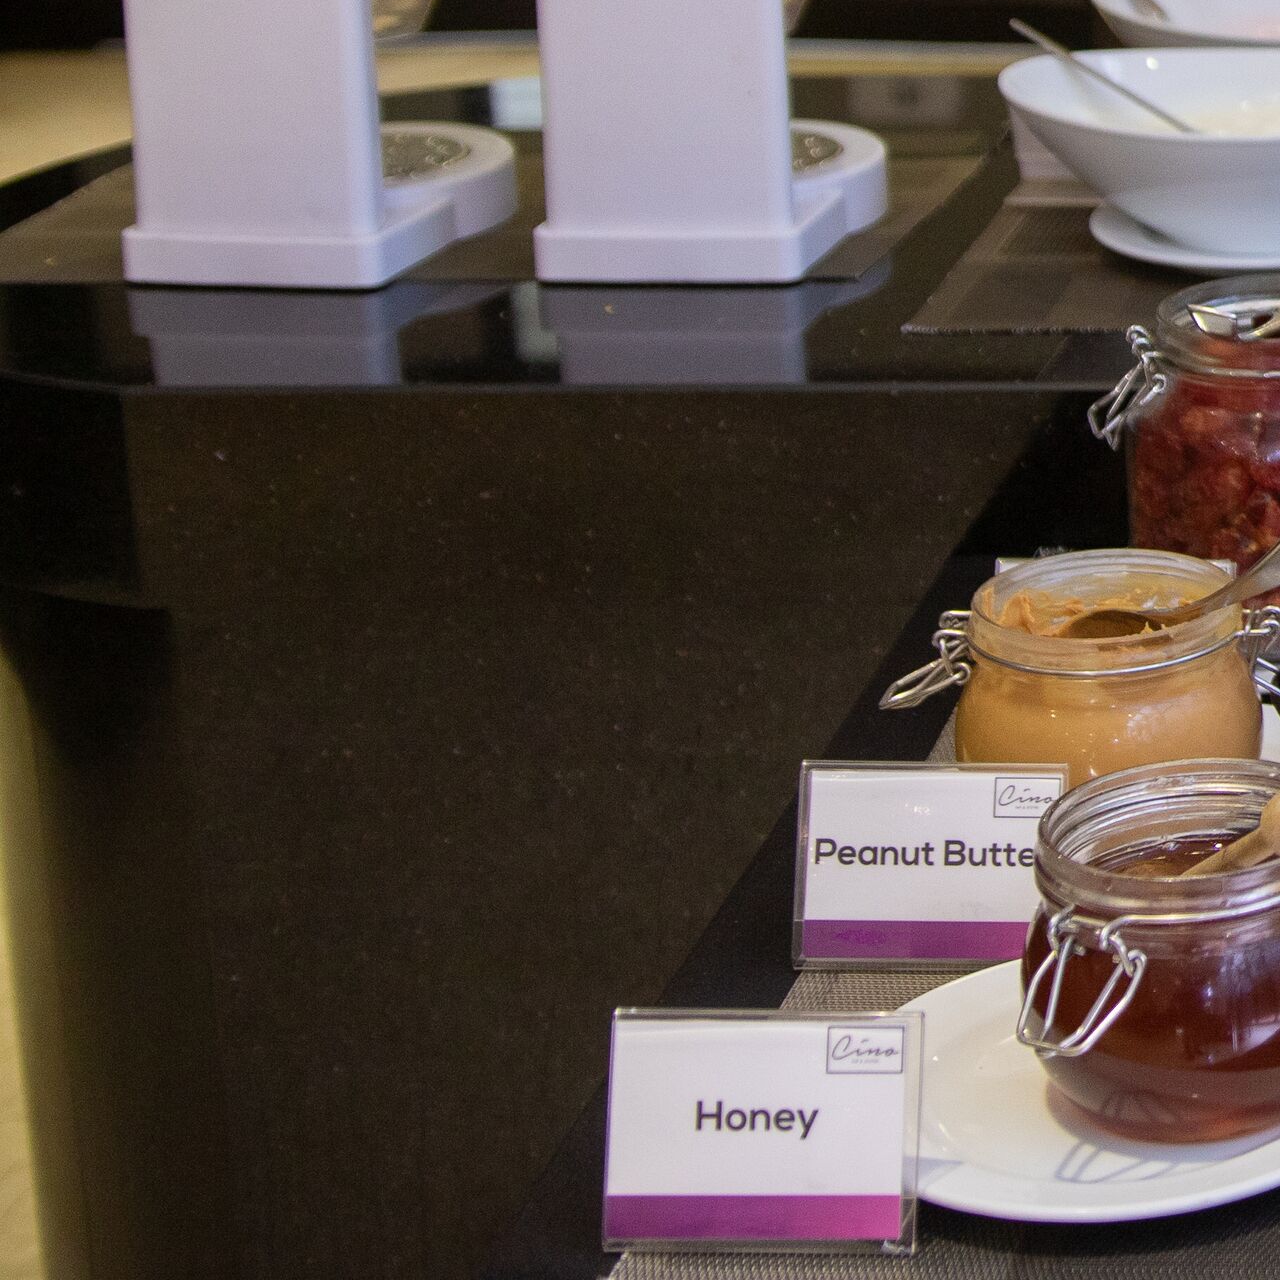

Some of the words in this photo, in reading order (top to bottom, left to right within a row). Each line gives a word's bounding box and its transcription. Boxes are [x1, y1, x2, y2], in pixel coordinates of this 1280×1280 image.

[999, 785, 1055, 806] Cino
[815, 838, 934, 866] Peanut
[944, 839, 1034, 867] Butte
[831, 1034, 899, 1060] Cino
[695, 1100, 819, 1140] Honey
